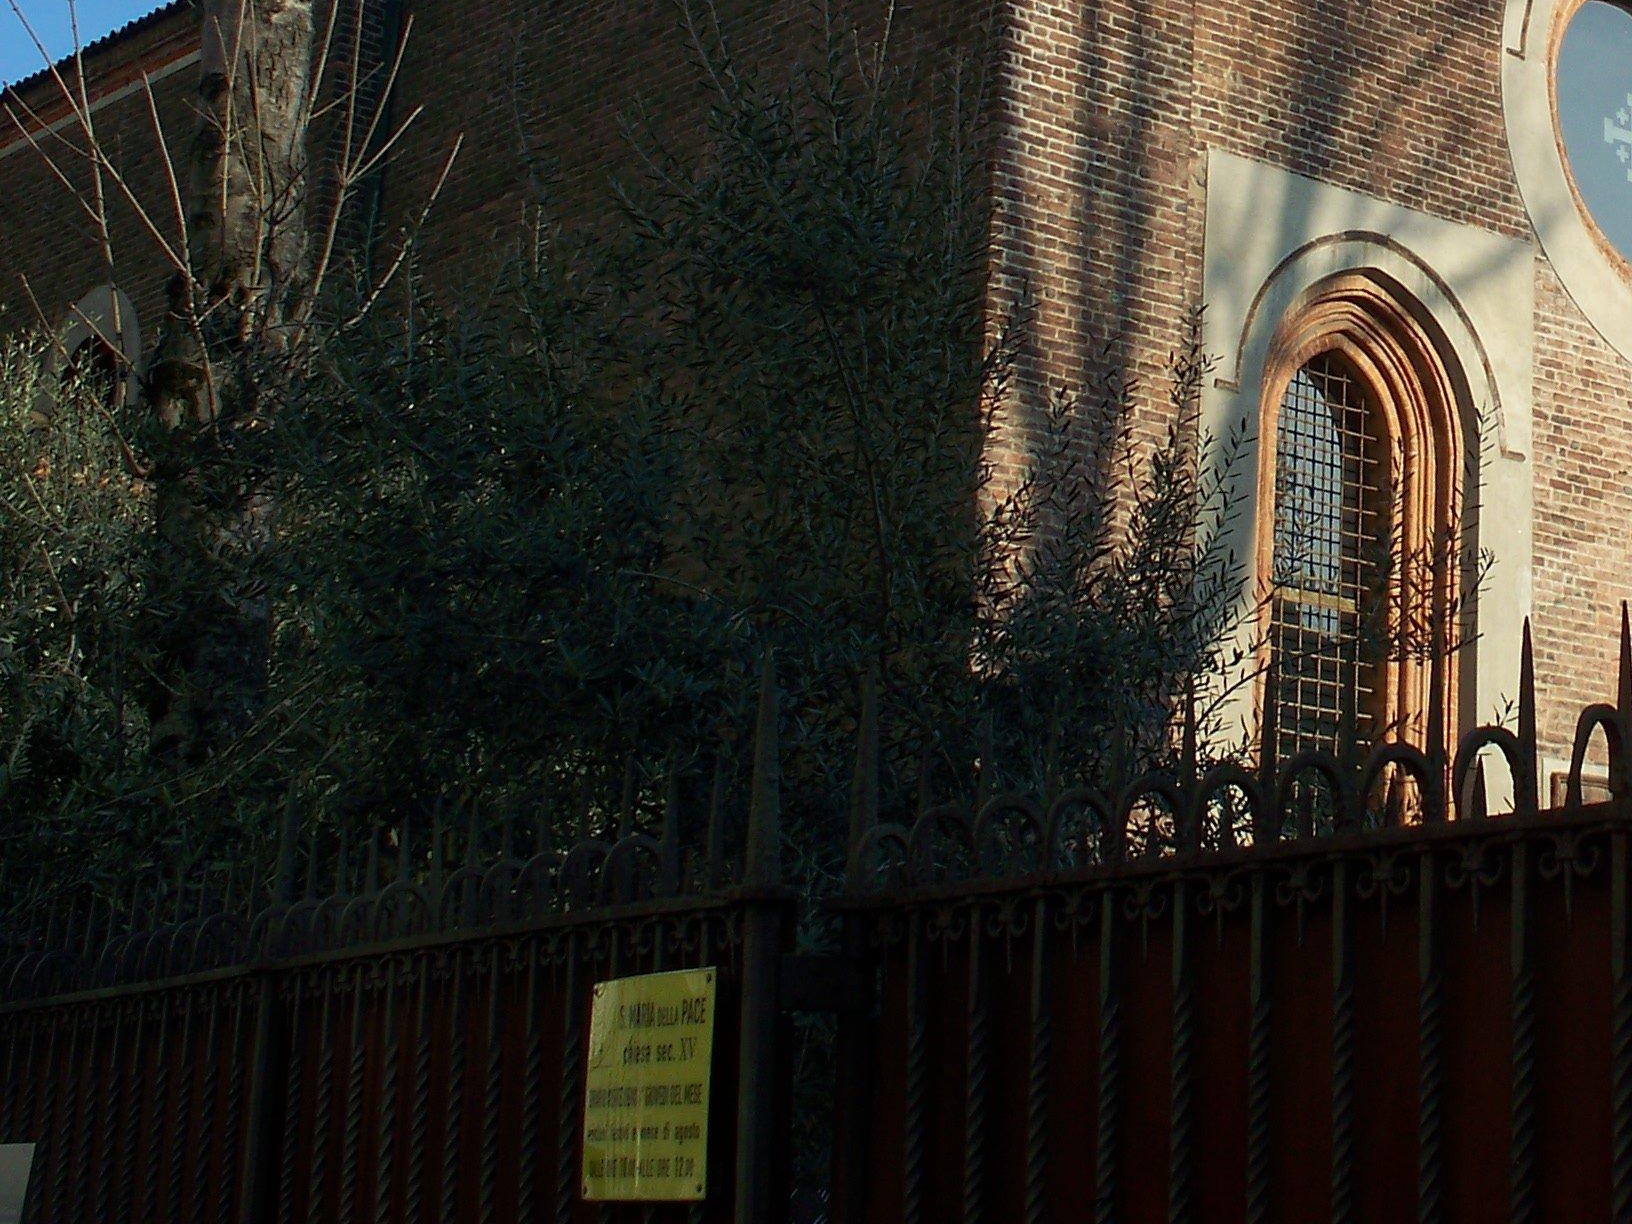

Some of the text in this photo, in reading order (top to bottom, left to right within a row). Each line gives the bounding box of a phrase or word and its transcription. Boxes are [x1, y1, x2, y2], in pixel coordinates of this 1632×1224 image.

[681, 997, 706, 1025] PACE
[679, 1037, 697, 1061] XV
[684, 1083, 703, 1105] MESE
